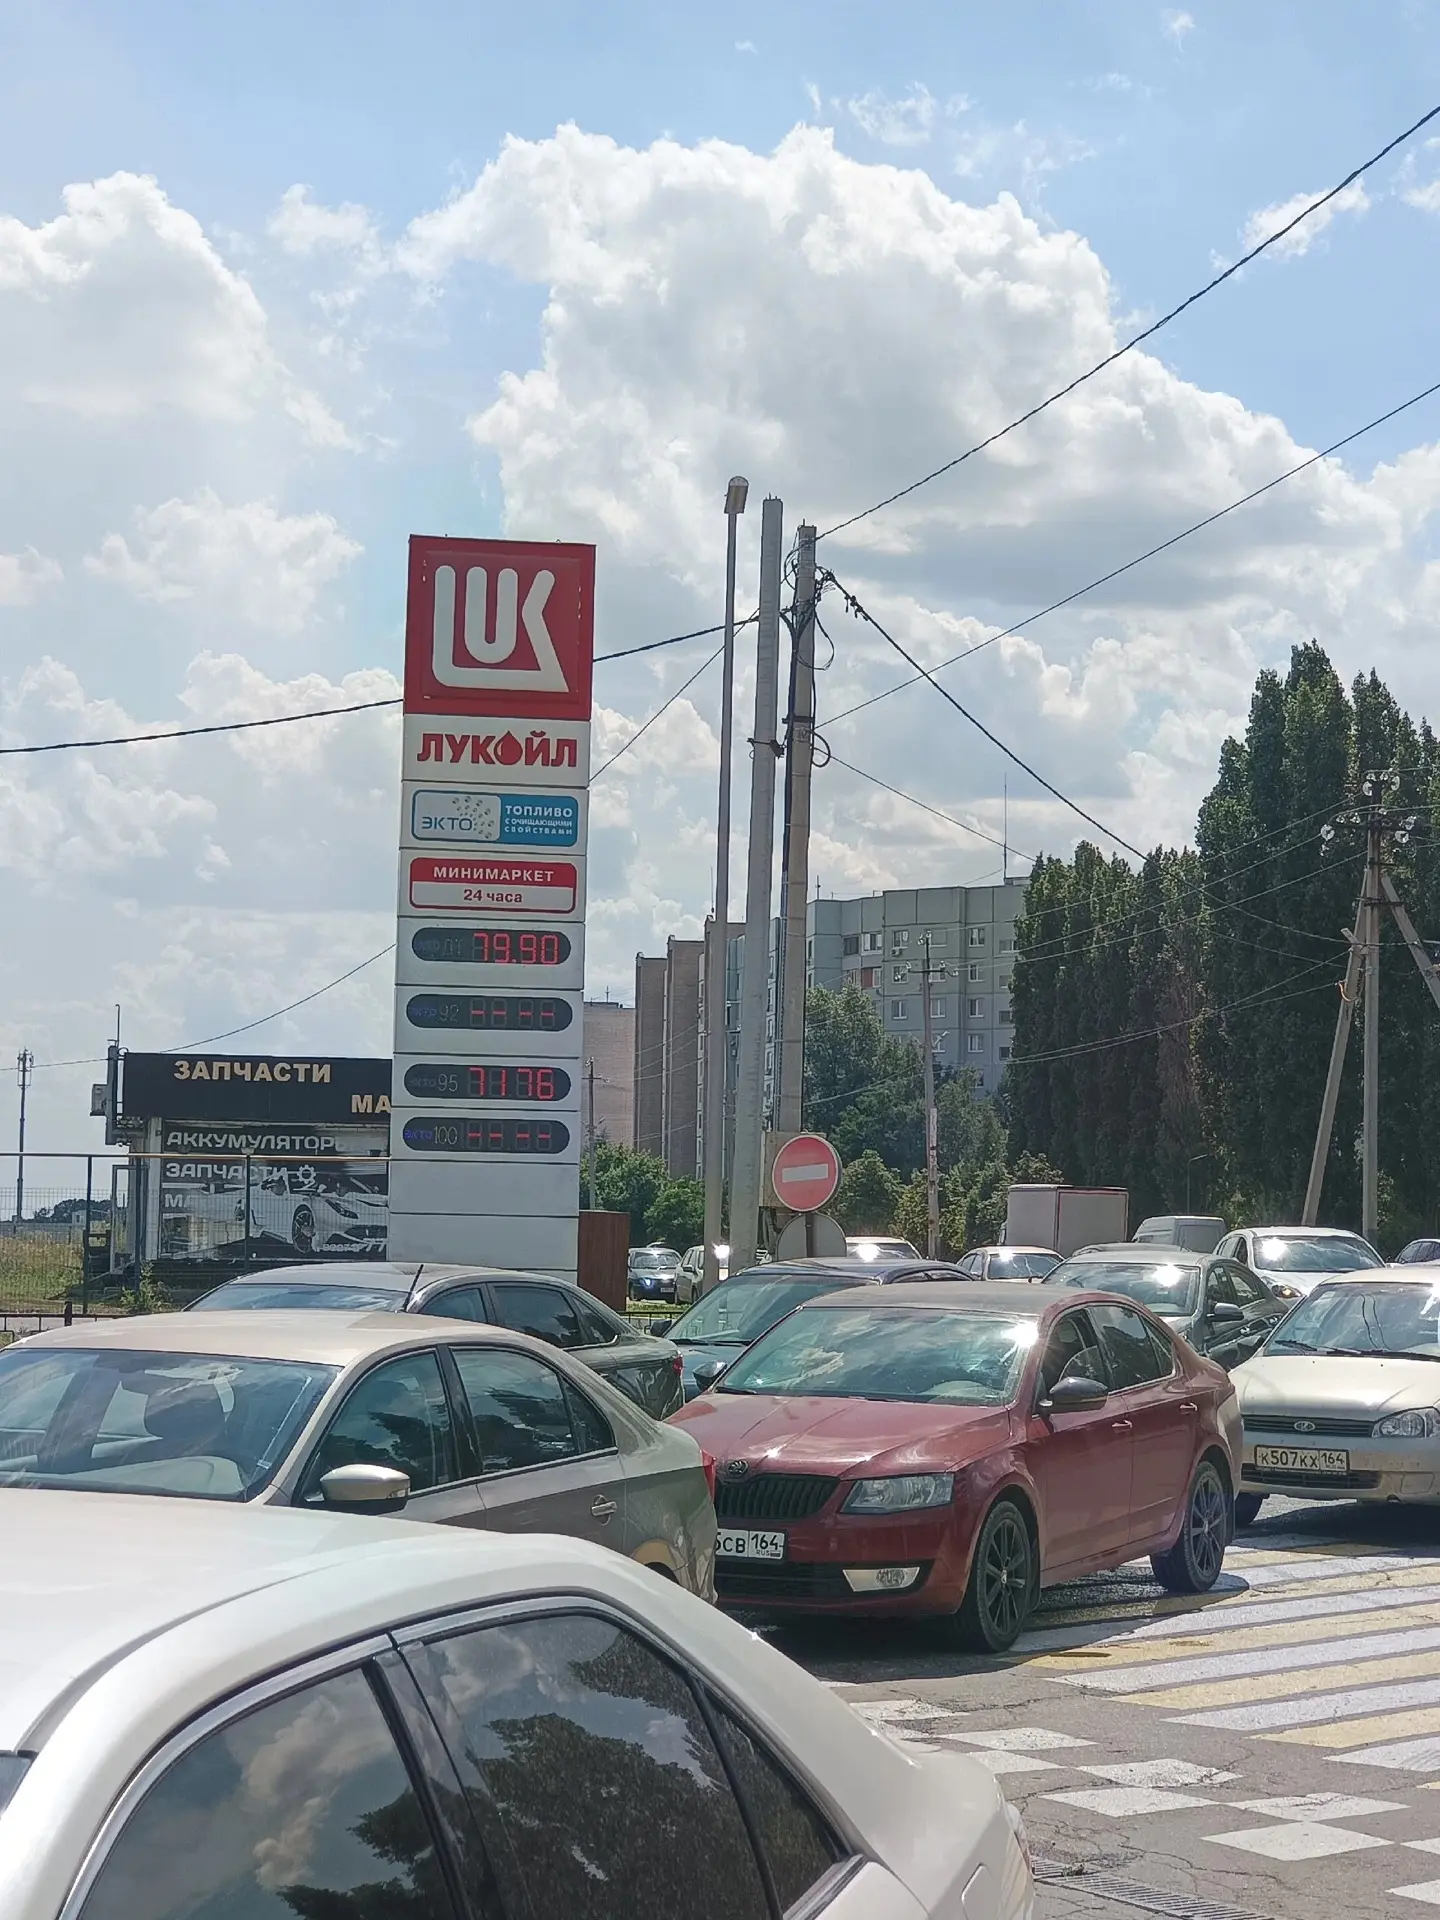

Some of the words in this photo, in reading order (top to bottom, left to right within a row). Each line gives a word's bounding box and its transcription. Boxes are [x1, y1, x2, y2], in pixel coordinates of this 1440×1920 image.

[417, 730, 578, 767] ЛУКОЙЛ
[505, 805, 573, 817] ТОПЛИВО
[421, 816, 473, 831] ЭКТО
[504, 826, 573, 835] СВОЙСТВАМИ
[511, 818, 573, 828] ОЧИЩАЮЩИМИ
[433, 866, 554, 882] МИНИМАРКЕТ
[463, 889, 483, 902] 24
[486, 892, 523, 903] часа
[473, 932, 559, 965] 79.90
[438, 1004, 460, 1023] 92
[174, 1060, 331, 1083] ЗАПЧАСТИ
[438, 1073, 458, 1092] 95
[433, 1126, 458, 1145] 100
[1320, 1452, 1345, 1465] 164
[751, 1533, 779, 1551] 164
